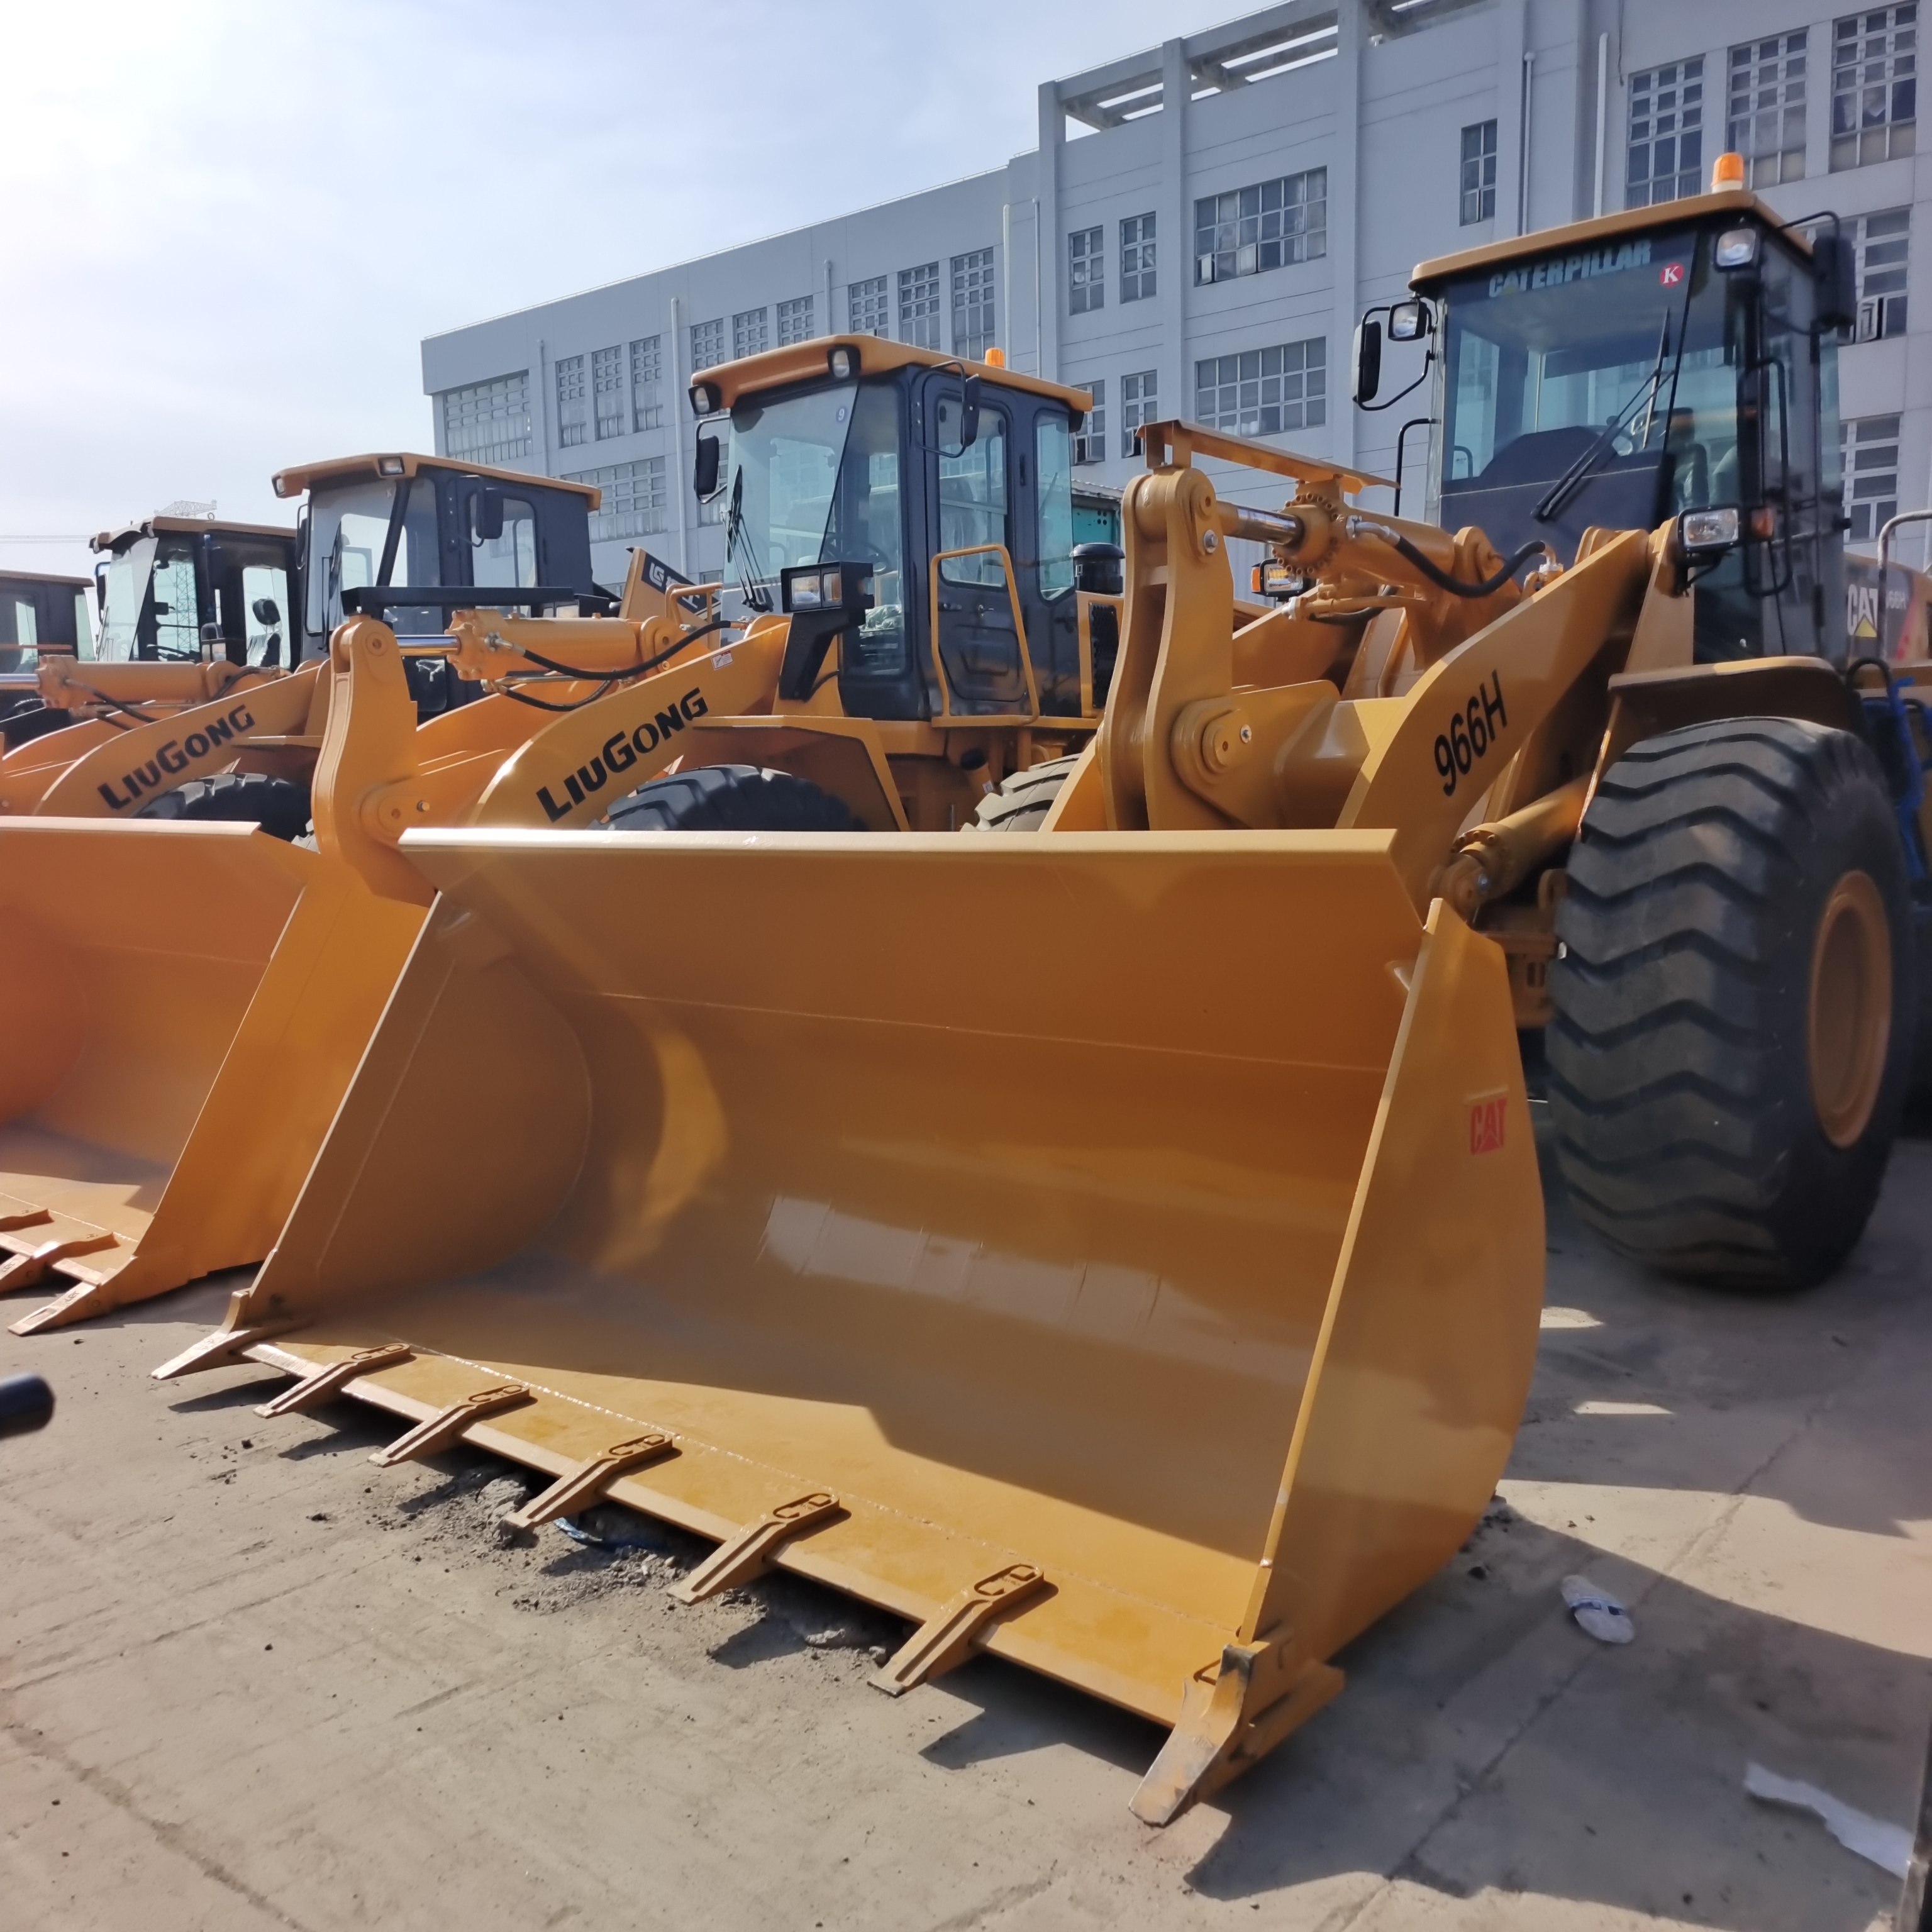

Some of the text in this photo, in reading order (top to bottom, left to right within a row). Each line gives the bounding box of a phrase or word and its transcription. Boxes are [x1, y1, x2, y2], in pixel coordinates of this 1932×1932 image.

[1489, 239, 1652, 298] CATERPILLAR
[1662, 265, 1680, 285] K
[1846, 584, 1879, 636] CAT
[1435, 669, 1507, 797] 966H
[1470, 1097, 1507, 1155] CAT
